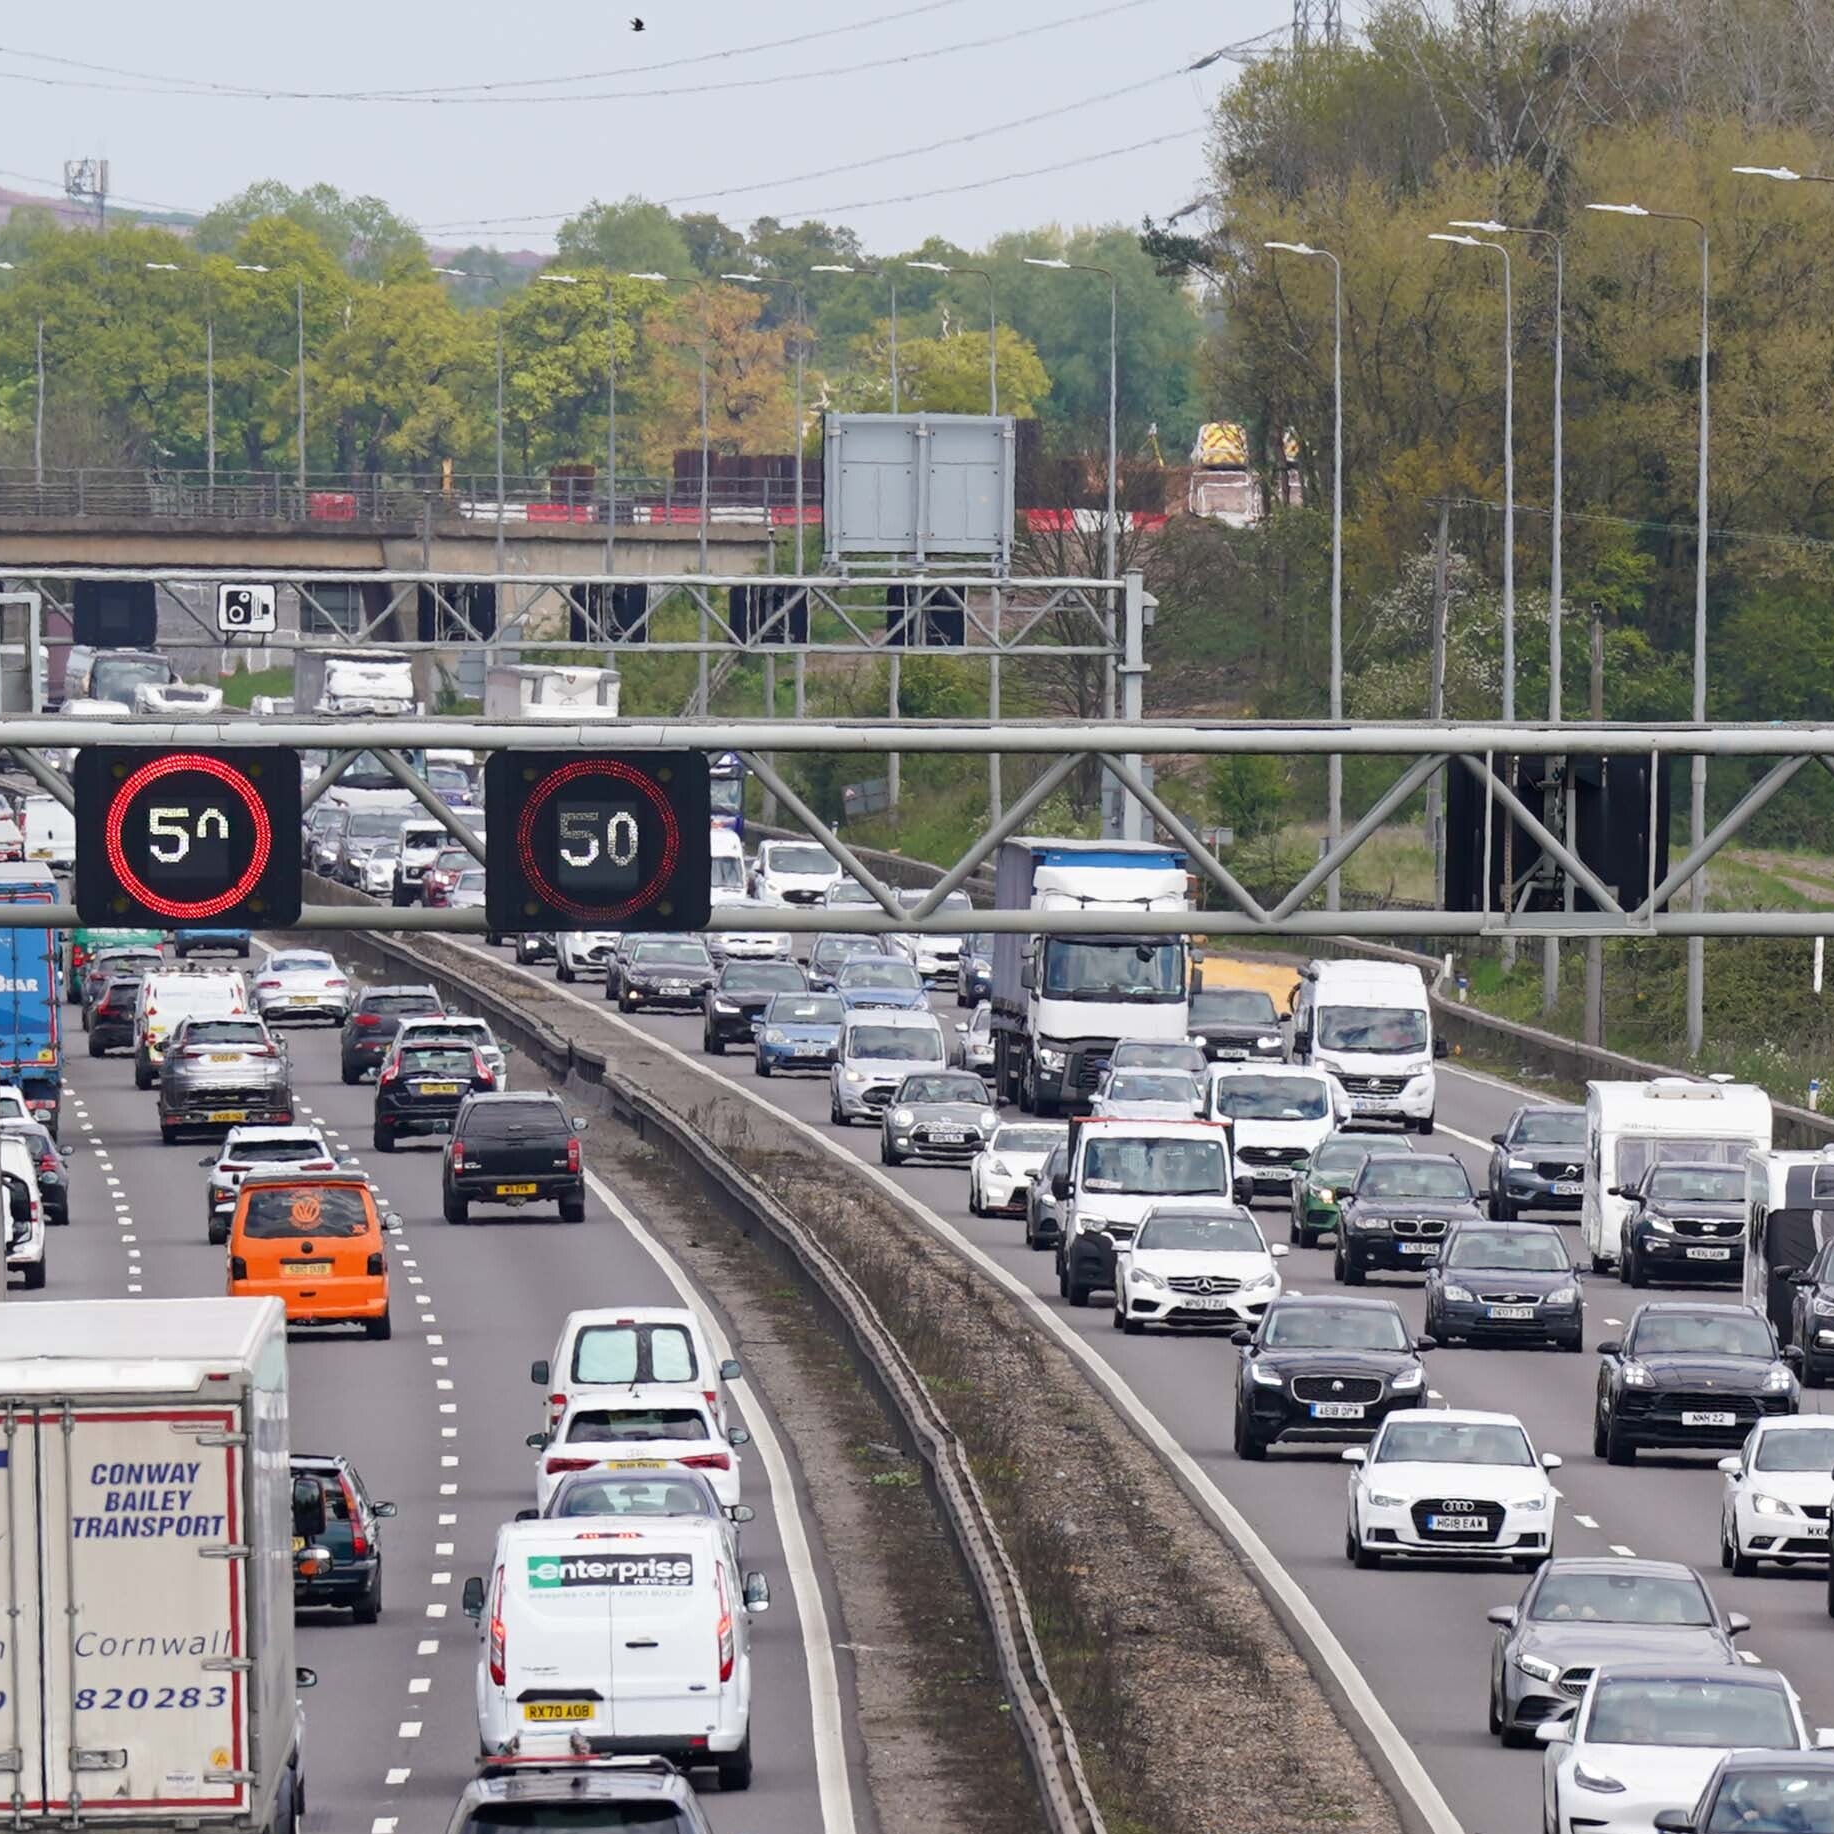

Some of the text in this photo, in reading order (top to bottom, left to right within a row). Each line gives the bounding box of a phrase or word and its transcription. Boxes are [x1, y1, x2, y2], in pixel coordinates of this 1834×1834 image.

[560, 811, 639, 866] 50
[90, 1461, 202, 1486] CONWAY
[104, 1489, 194, 1512] BAILEY
[72, 1514, 227, 1539] TRANSPORT
[531, 1558, 692, 1582] enterprise
[75, 1629, 235, 1660] Cornwall
[74, 1686, 229, 1712] 820283
[529, 1705, 563, 1718] RX70
